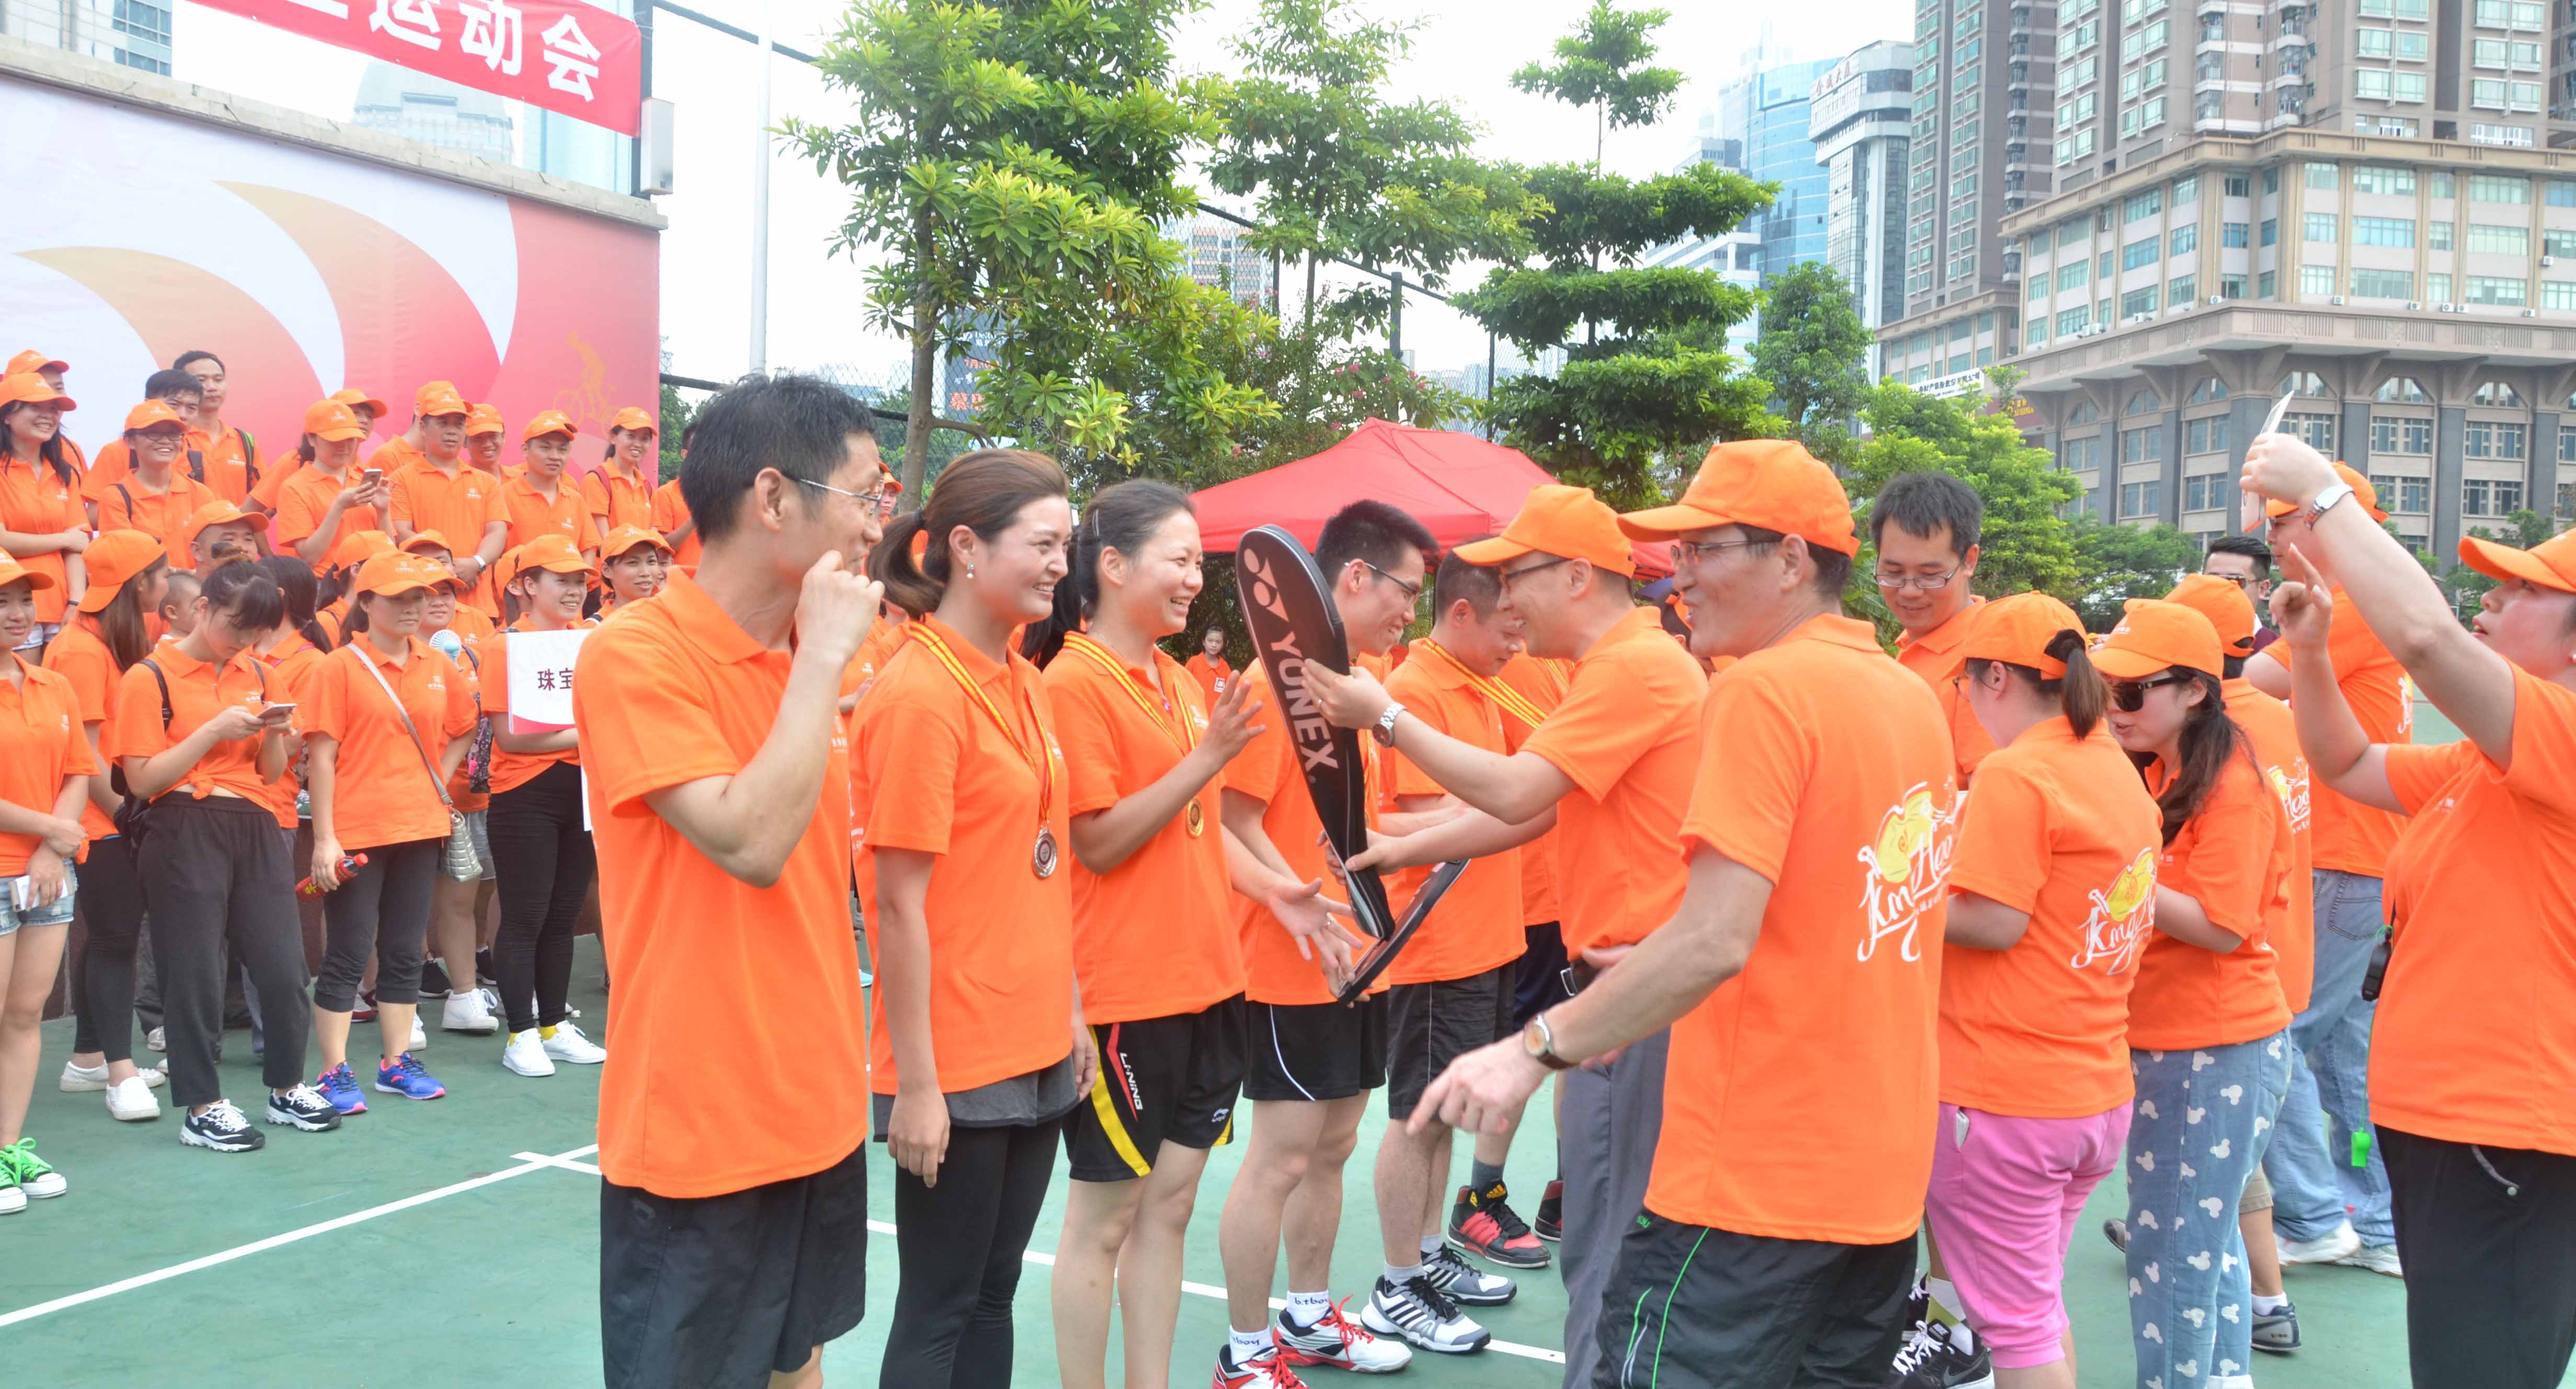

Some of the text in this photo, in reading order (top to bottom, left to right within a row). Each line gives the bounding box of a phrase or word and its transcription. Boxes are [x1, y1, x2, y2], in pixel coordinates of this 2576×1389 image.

[303, 0, 601, 102] 运动会
[537, 668, 573, 691] 珠宝
[1271, 631, 1339, 772] YONEX
